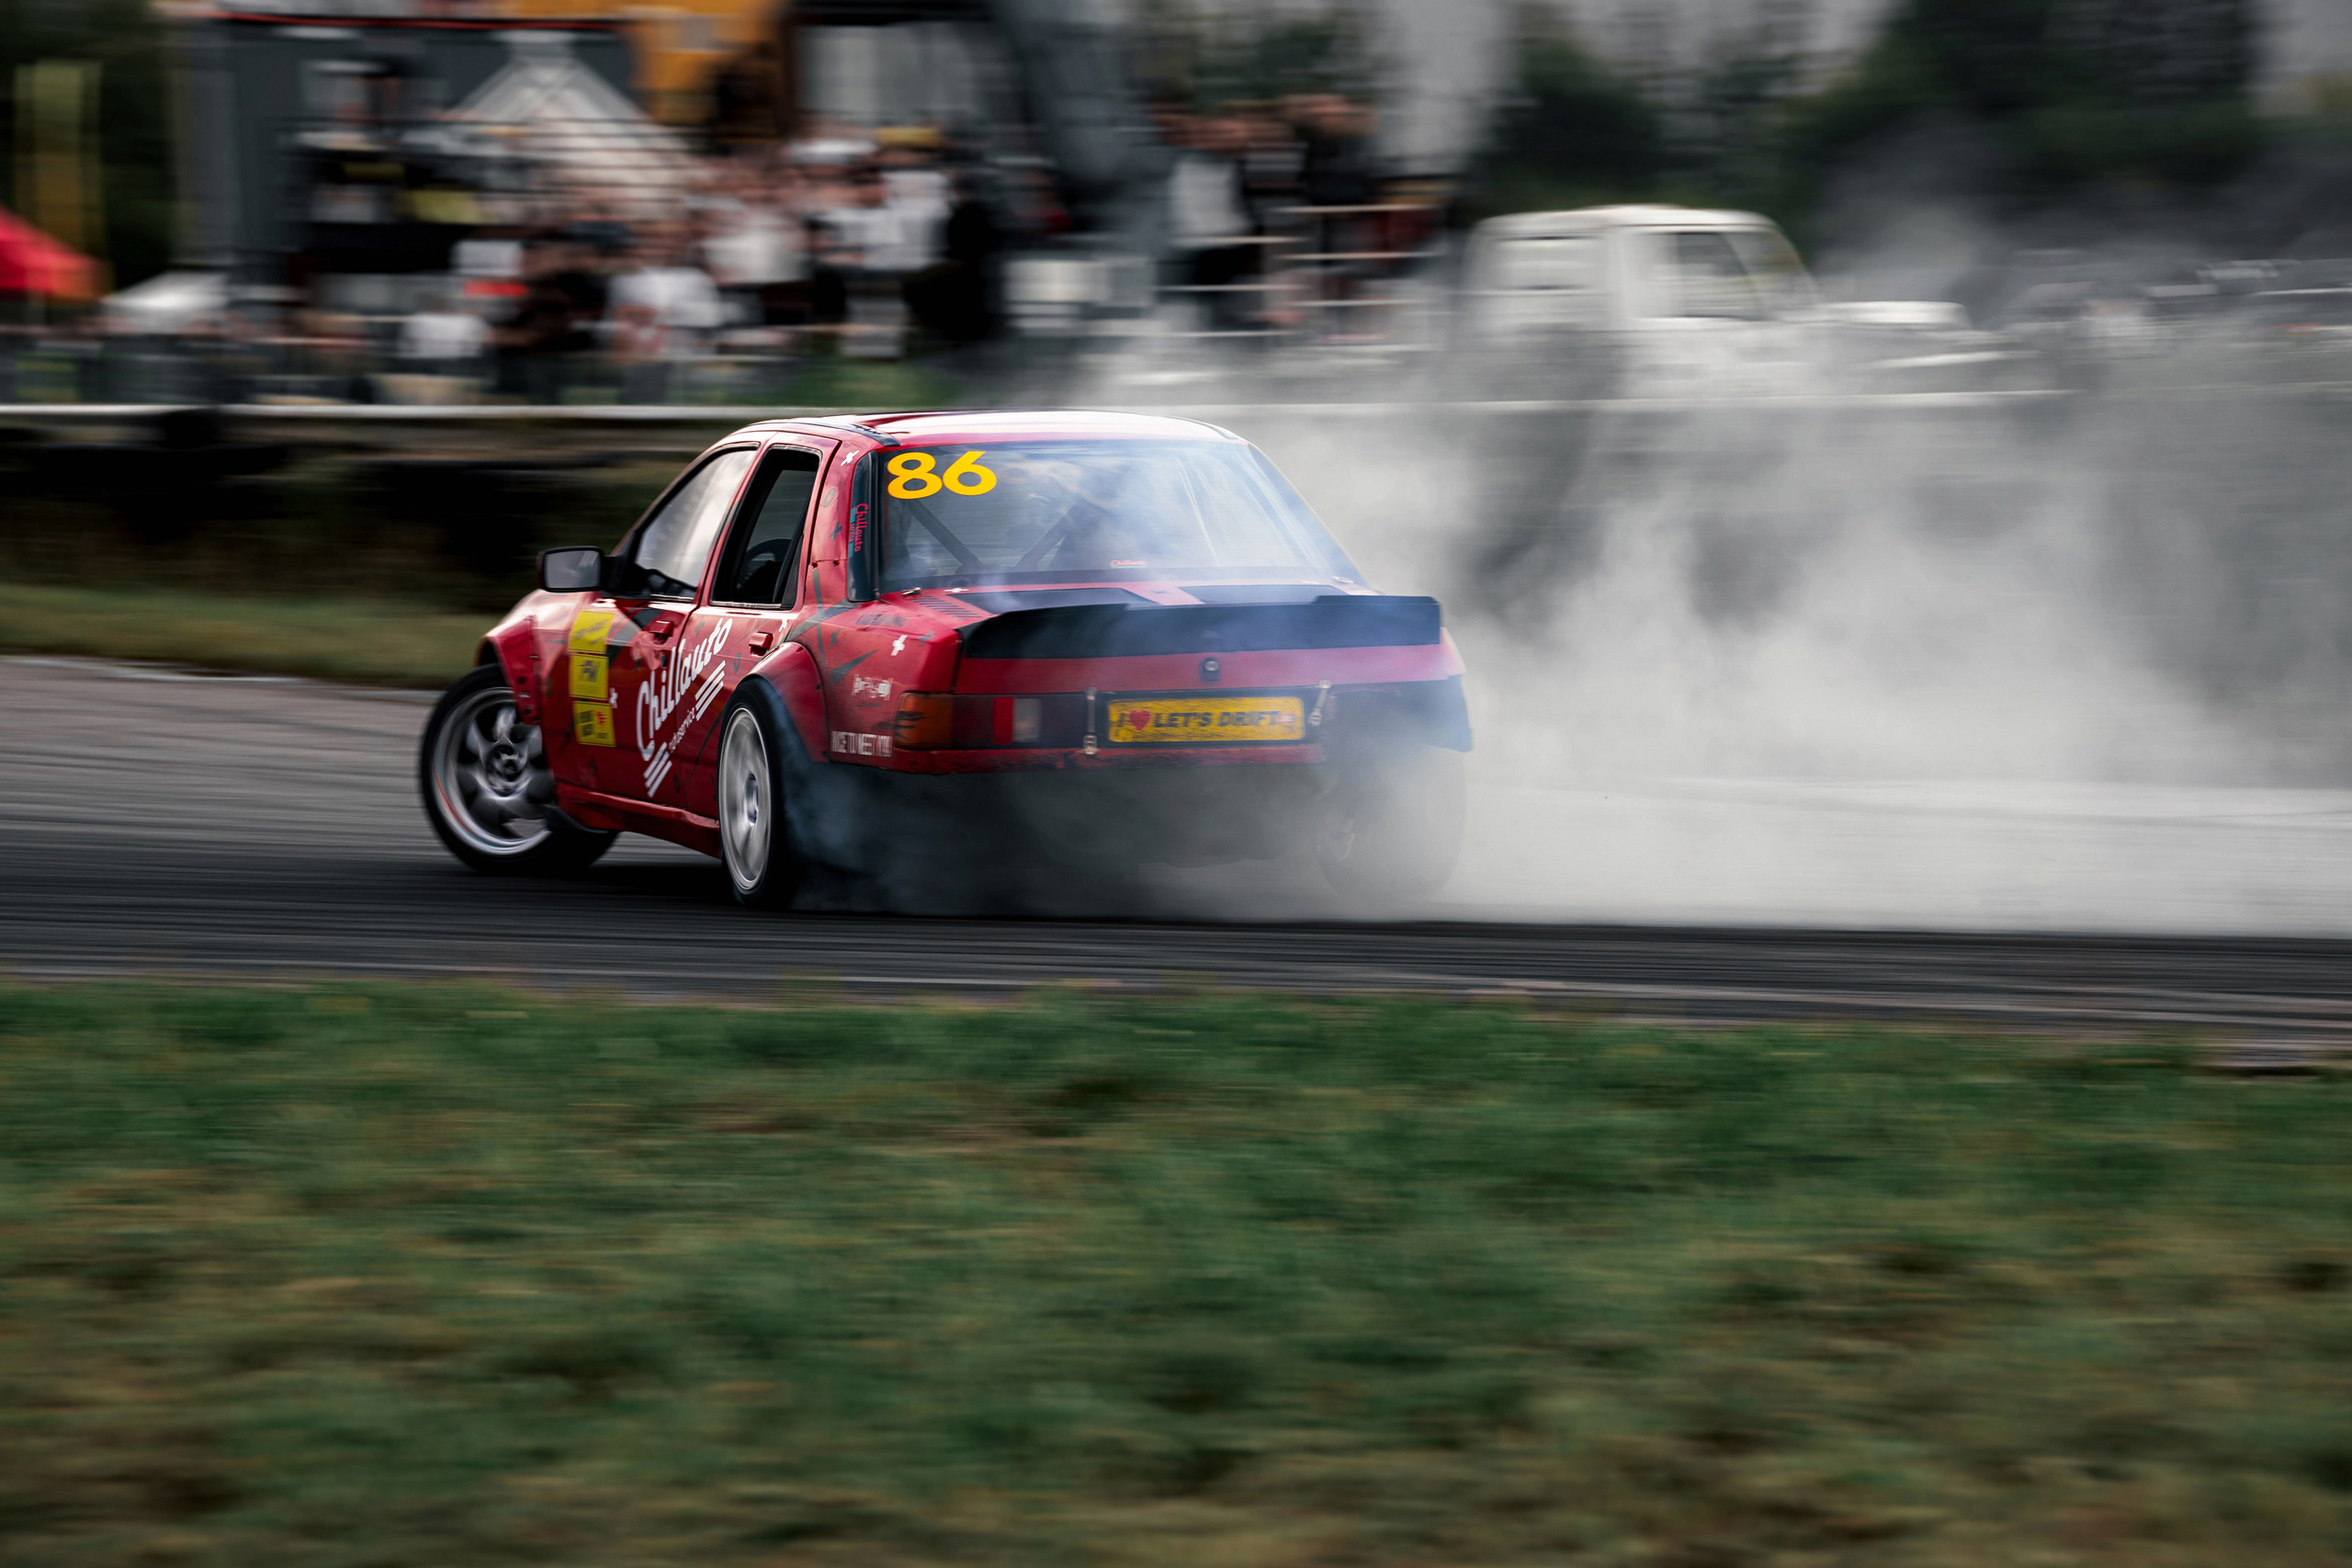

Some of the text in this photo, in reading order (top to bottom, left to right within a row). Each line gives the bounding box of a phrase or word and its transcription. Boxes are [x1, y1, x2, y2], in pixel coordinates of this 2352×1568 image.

[887, 451, 998, 500] 86
[854, 502, 869, 552] Chillauto
[636, 616, 734, 761] Chillauto
[1153, 712, 1213, 728] LET'S
[1217, 710, 1280, 727] DRIFT
